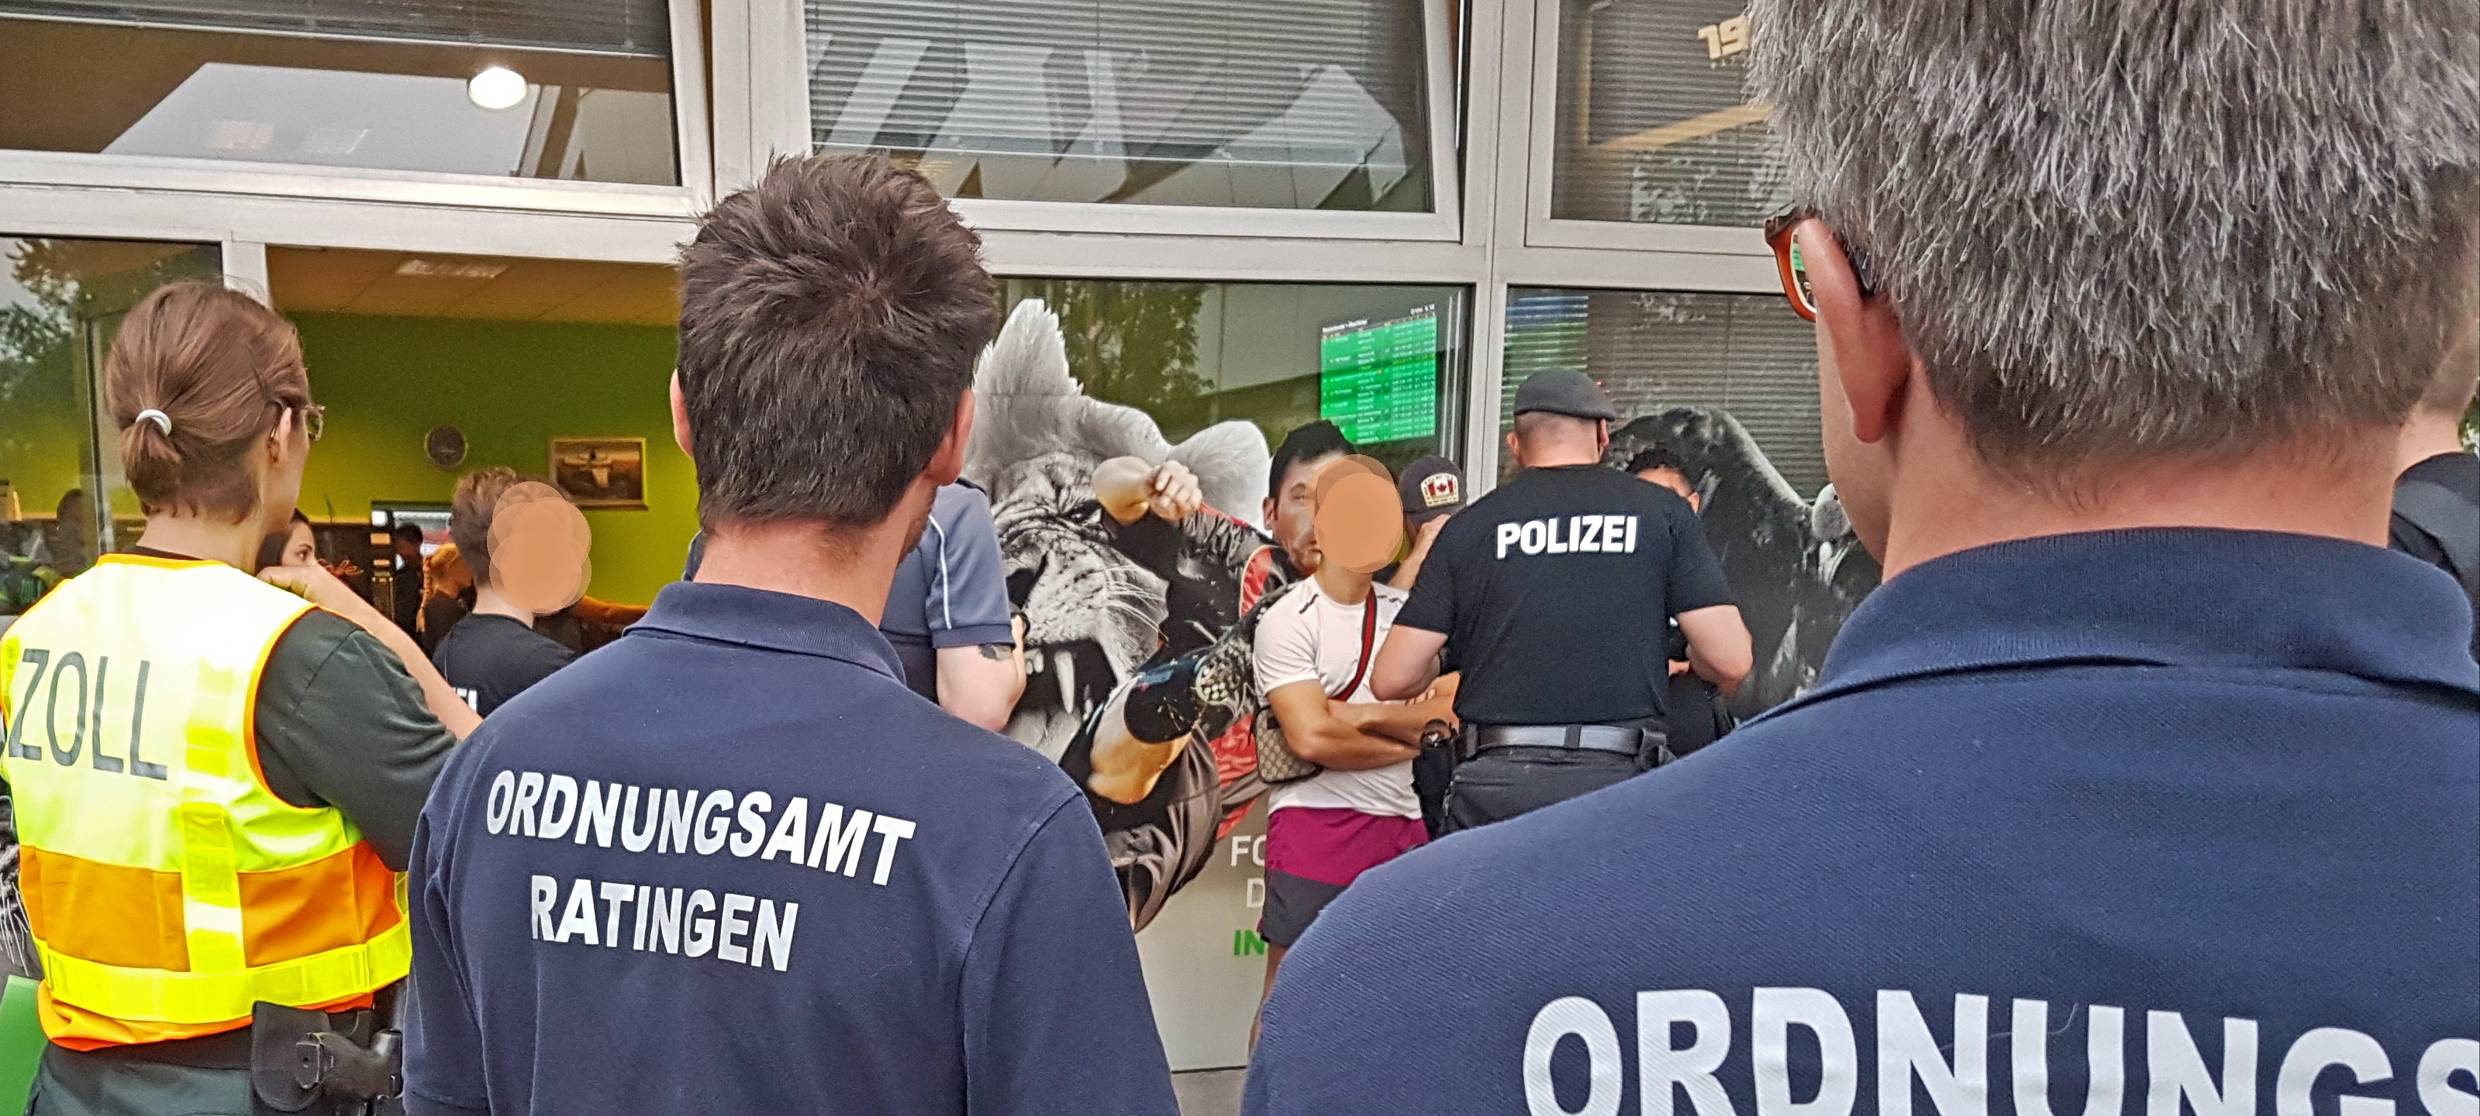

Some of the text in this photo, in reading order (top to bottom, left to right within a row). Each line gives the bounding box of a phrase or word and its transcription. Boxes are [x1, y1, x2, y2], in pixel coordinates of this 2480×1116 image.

[1496, 514, 1638, 560] POLIZEI
[8, 648, 168, 781] ZOLL
[486, 769, 917, 886] ORDNUNGSAMT
[531, 874, 800, 972] RATINGEN
